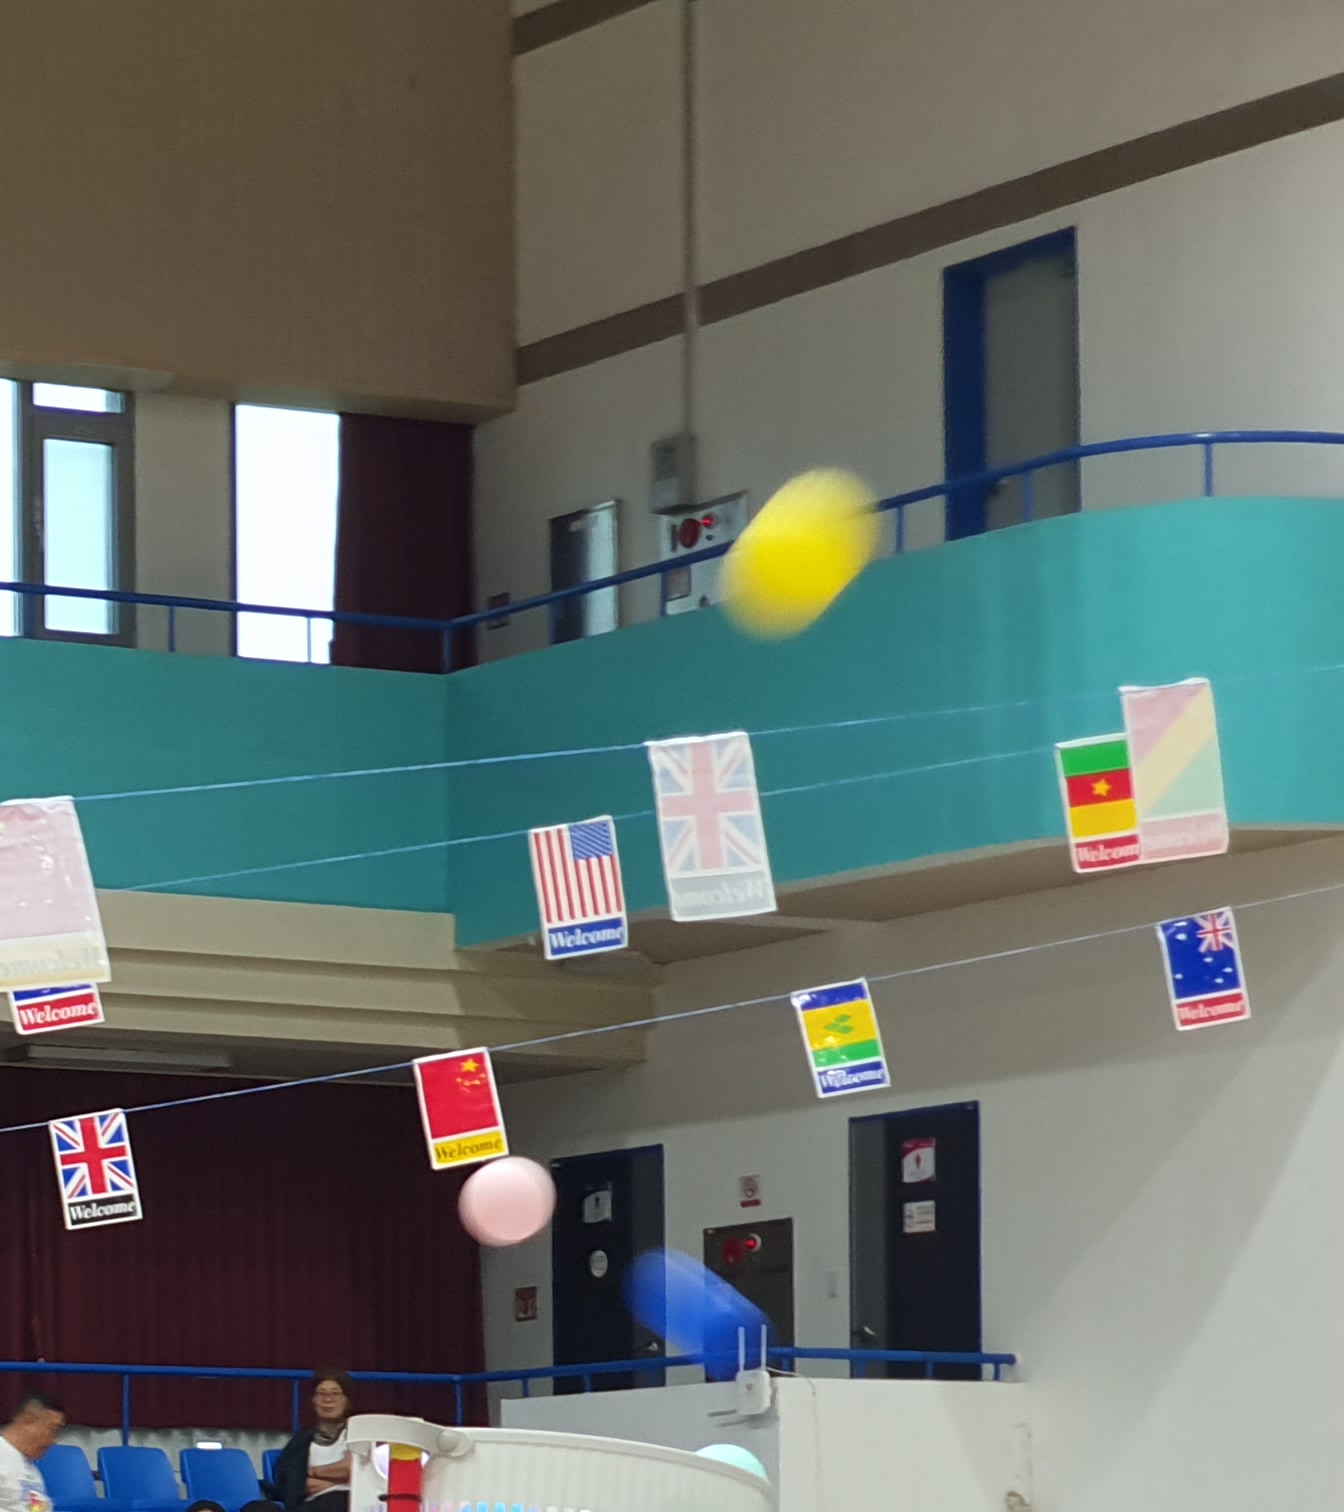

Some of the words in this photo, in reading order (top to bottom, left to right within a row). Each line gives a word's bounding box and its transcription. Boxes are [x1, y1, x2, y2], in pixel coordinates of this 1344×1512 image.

[19, 1002, 97, 1025] Welcome
[434, 1139, 502, 1160] Welcome
[70, 1201, 136, 1220] Welcome
